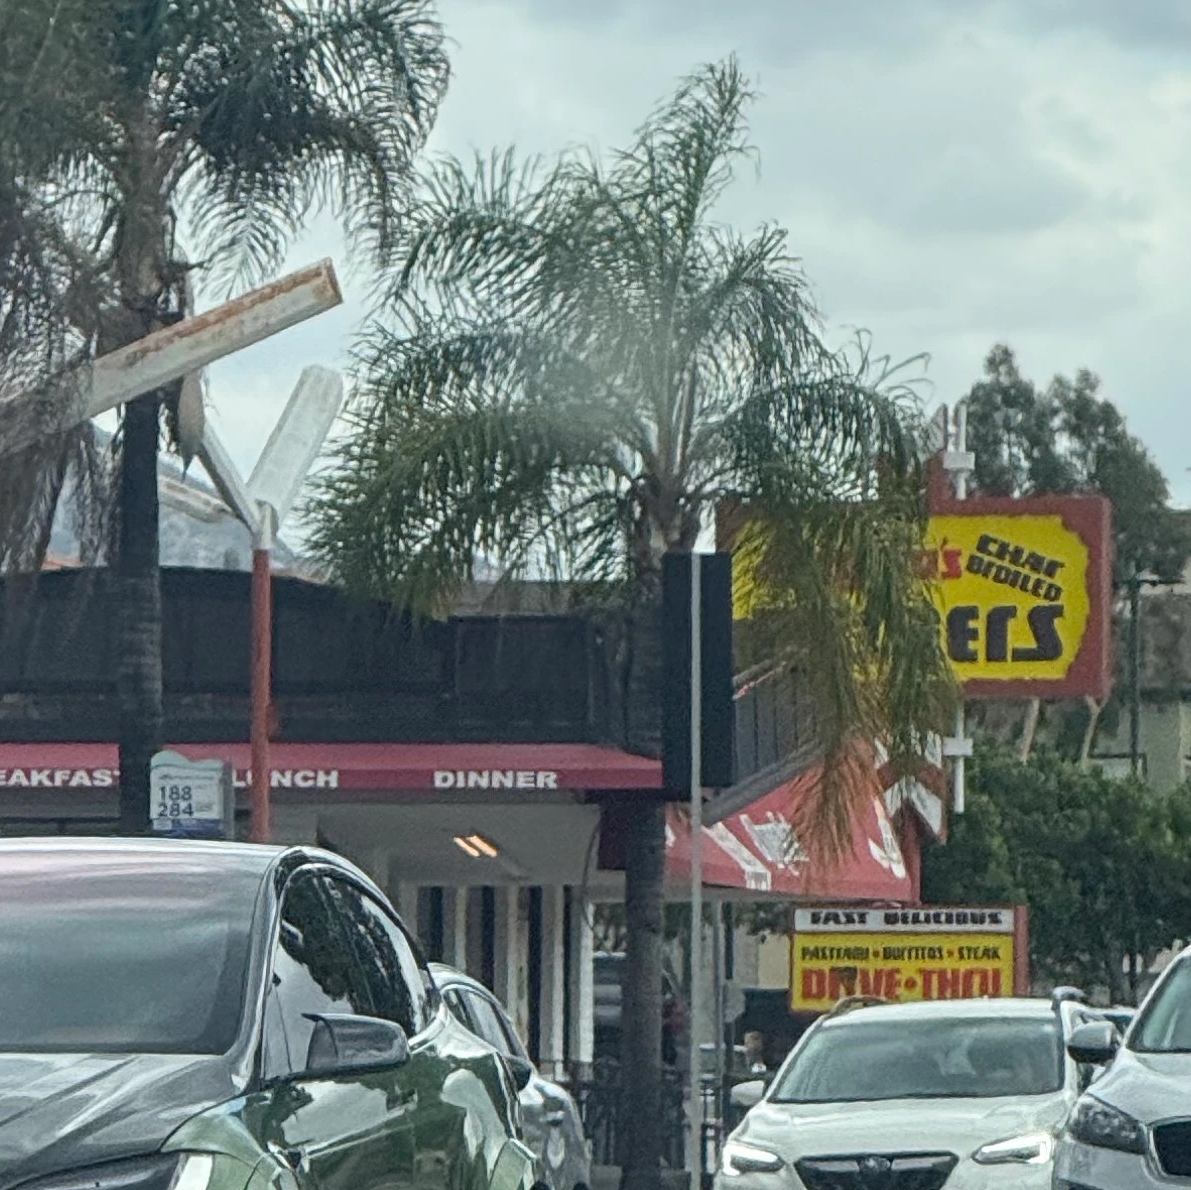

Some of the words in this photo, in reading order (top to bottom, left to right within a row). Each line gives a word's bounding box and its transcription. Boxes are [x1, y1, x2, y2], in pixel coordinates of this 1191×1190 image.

[433, 769, 559, 789] DINNER
[159, 785, 192, 801] 188
[158, 802, 194, 817] 284
[811, 911, 870, 925] FAST
[884, 911, 1003, 925] DELICIOUS
